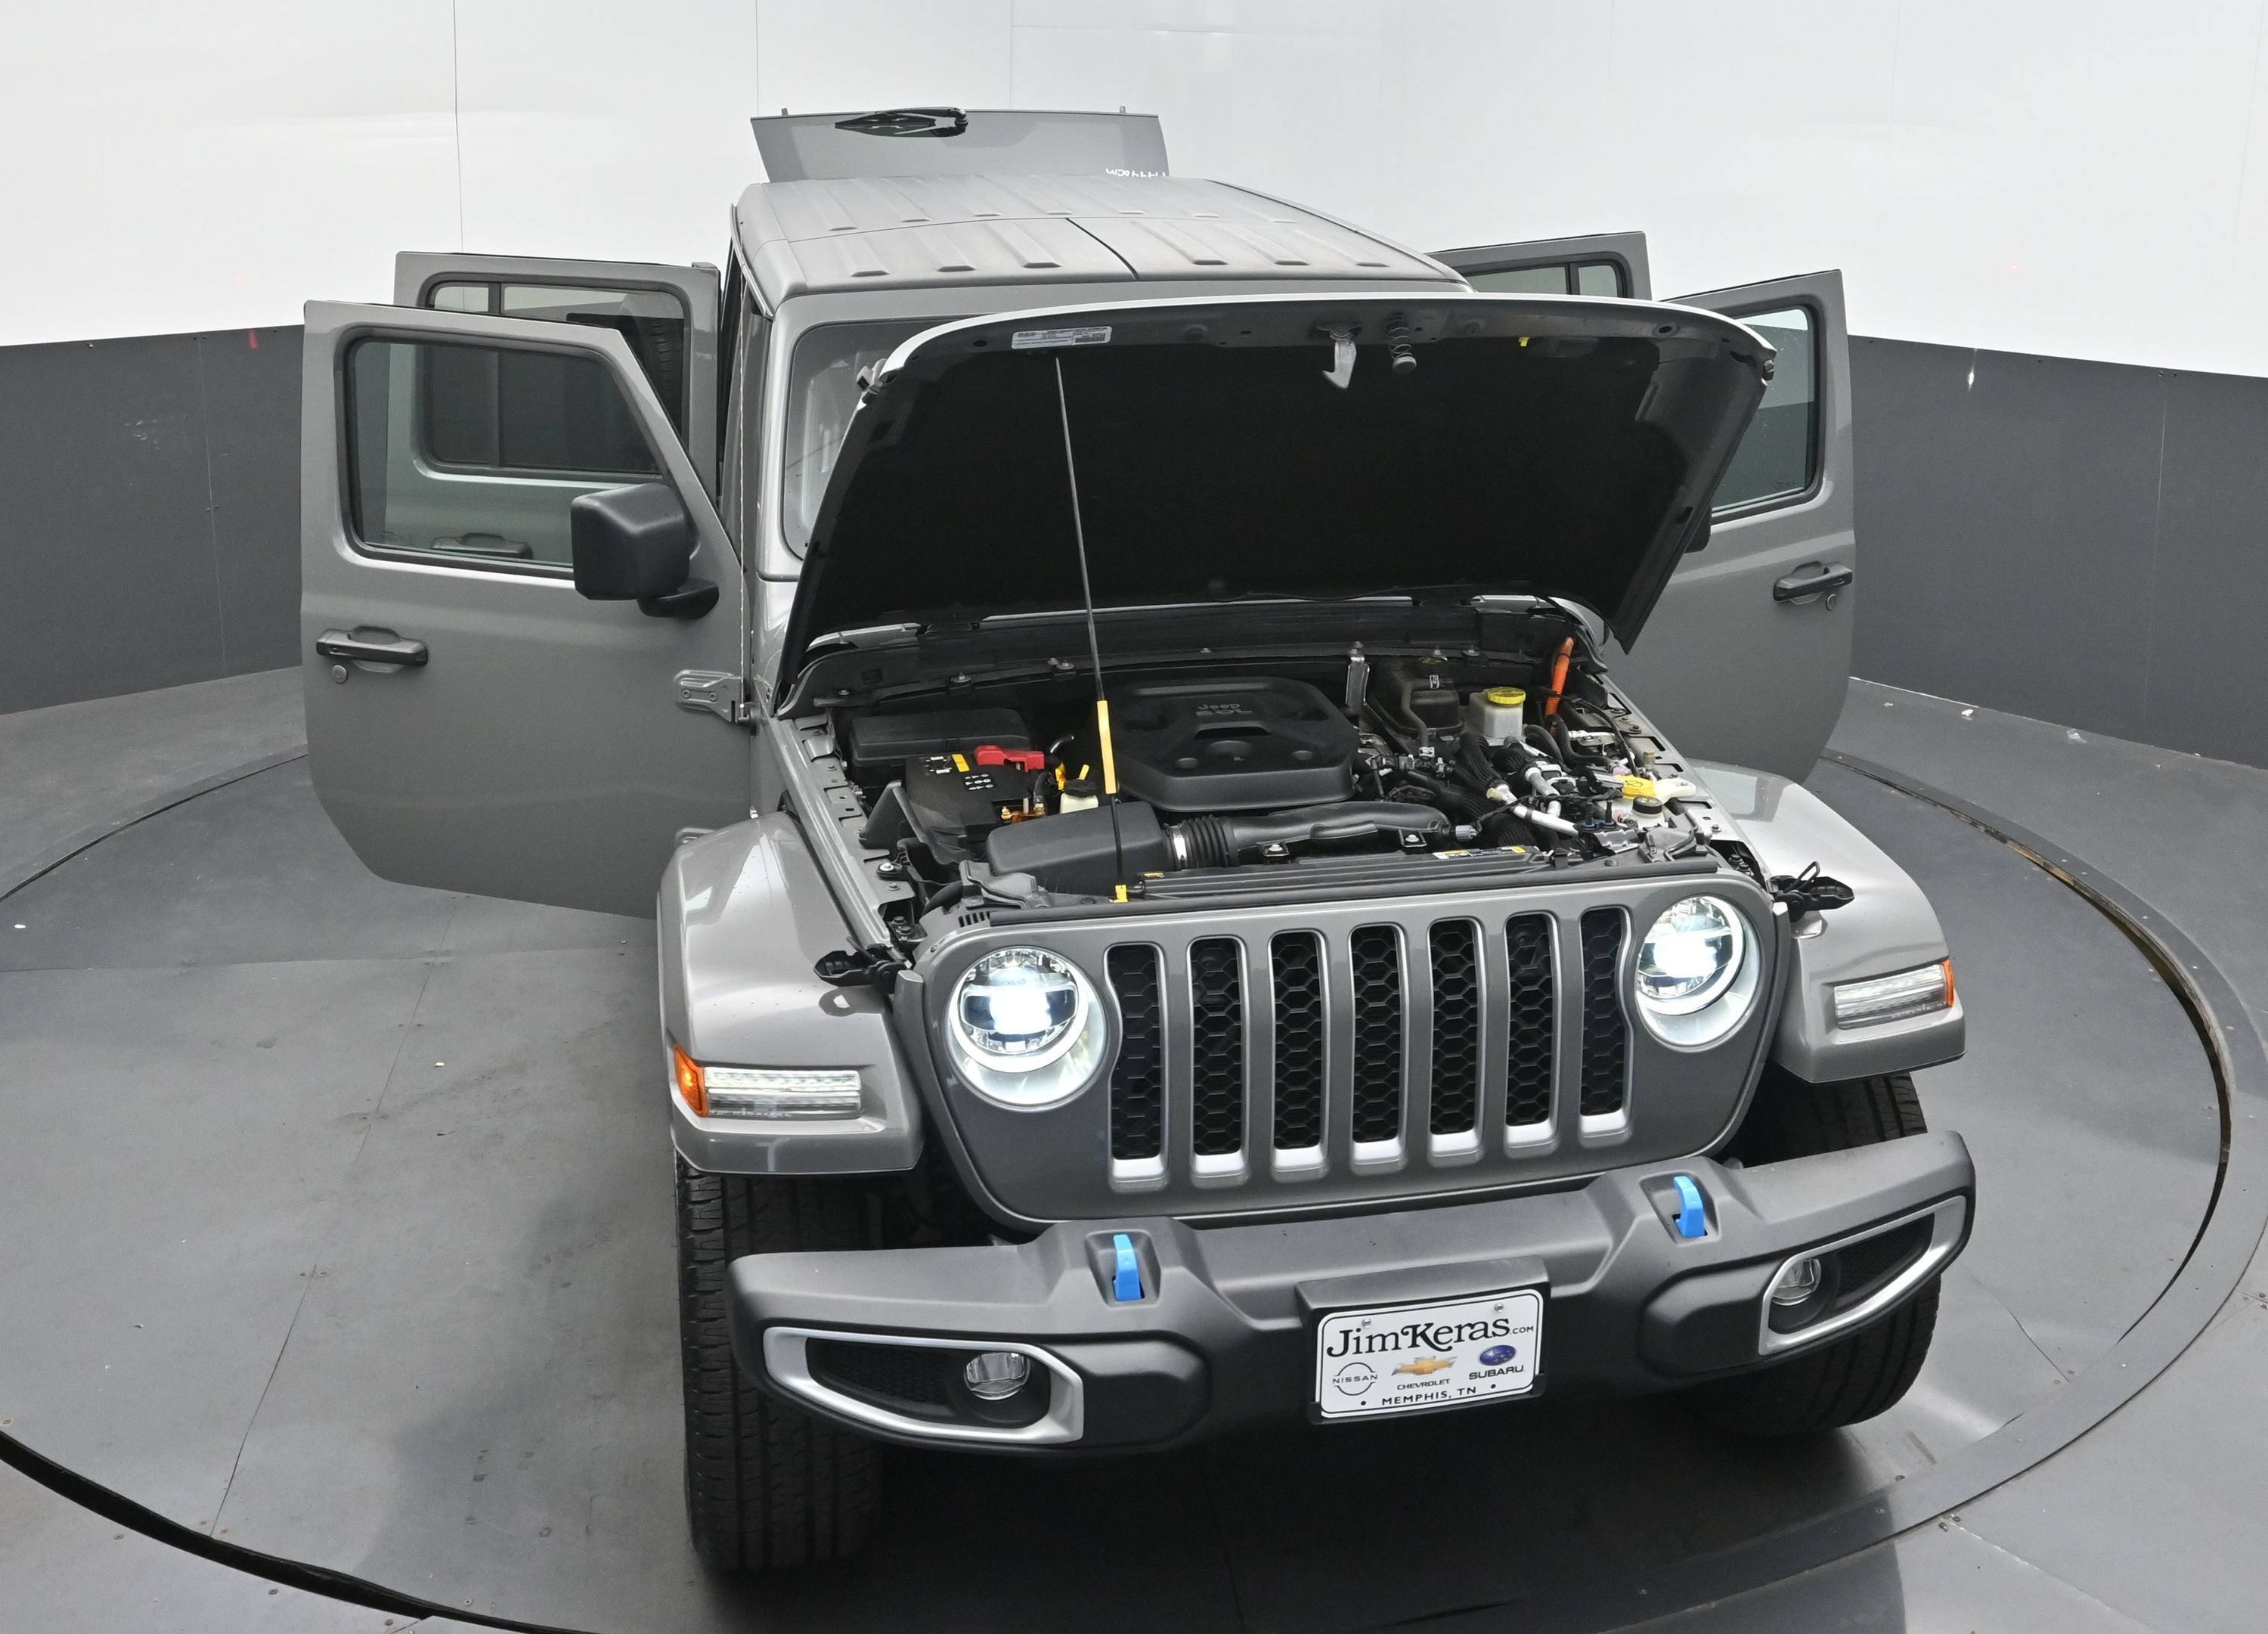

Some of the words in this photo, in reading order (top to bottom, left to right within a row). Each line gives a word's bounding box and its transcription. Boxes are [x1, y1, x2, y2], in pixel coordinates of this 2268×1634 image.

[1332, 1374, 1378, 1384] NISSAN
[1468, 1364, 1524, 1380] SUBARU
[1396, 1378, 1451, 1391] CHEVROLET
[1381, 1391, 1452, 1406] MEMPHIS,
[1457, 1386, 1476, 1397] TN
